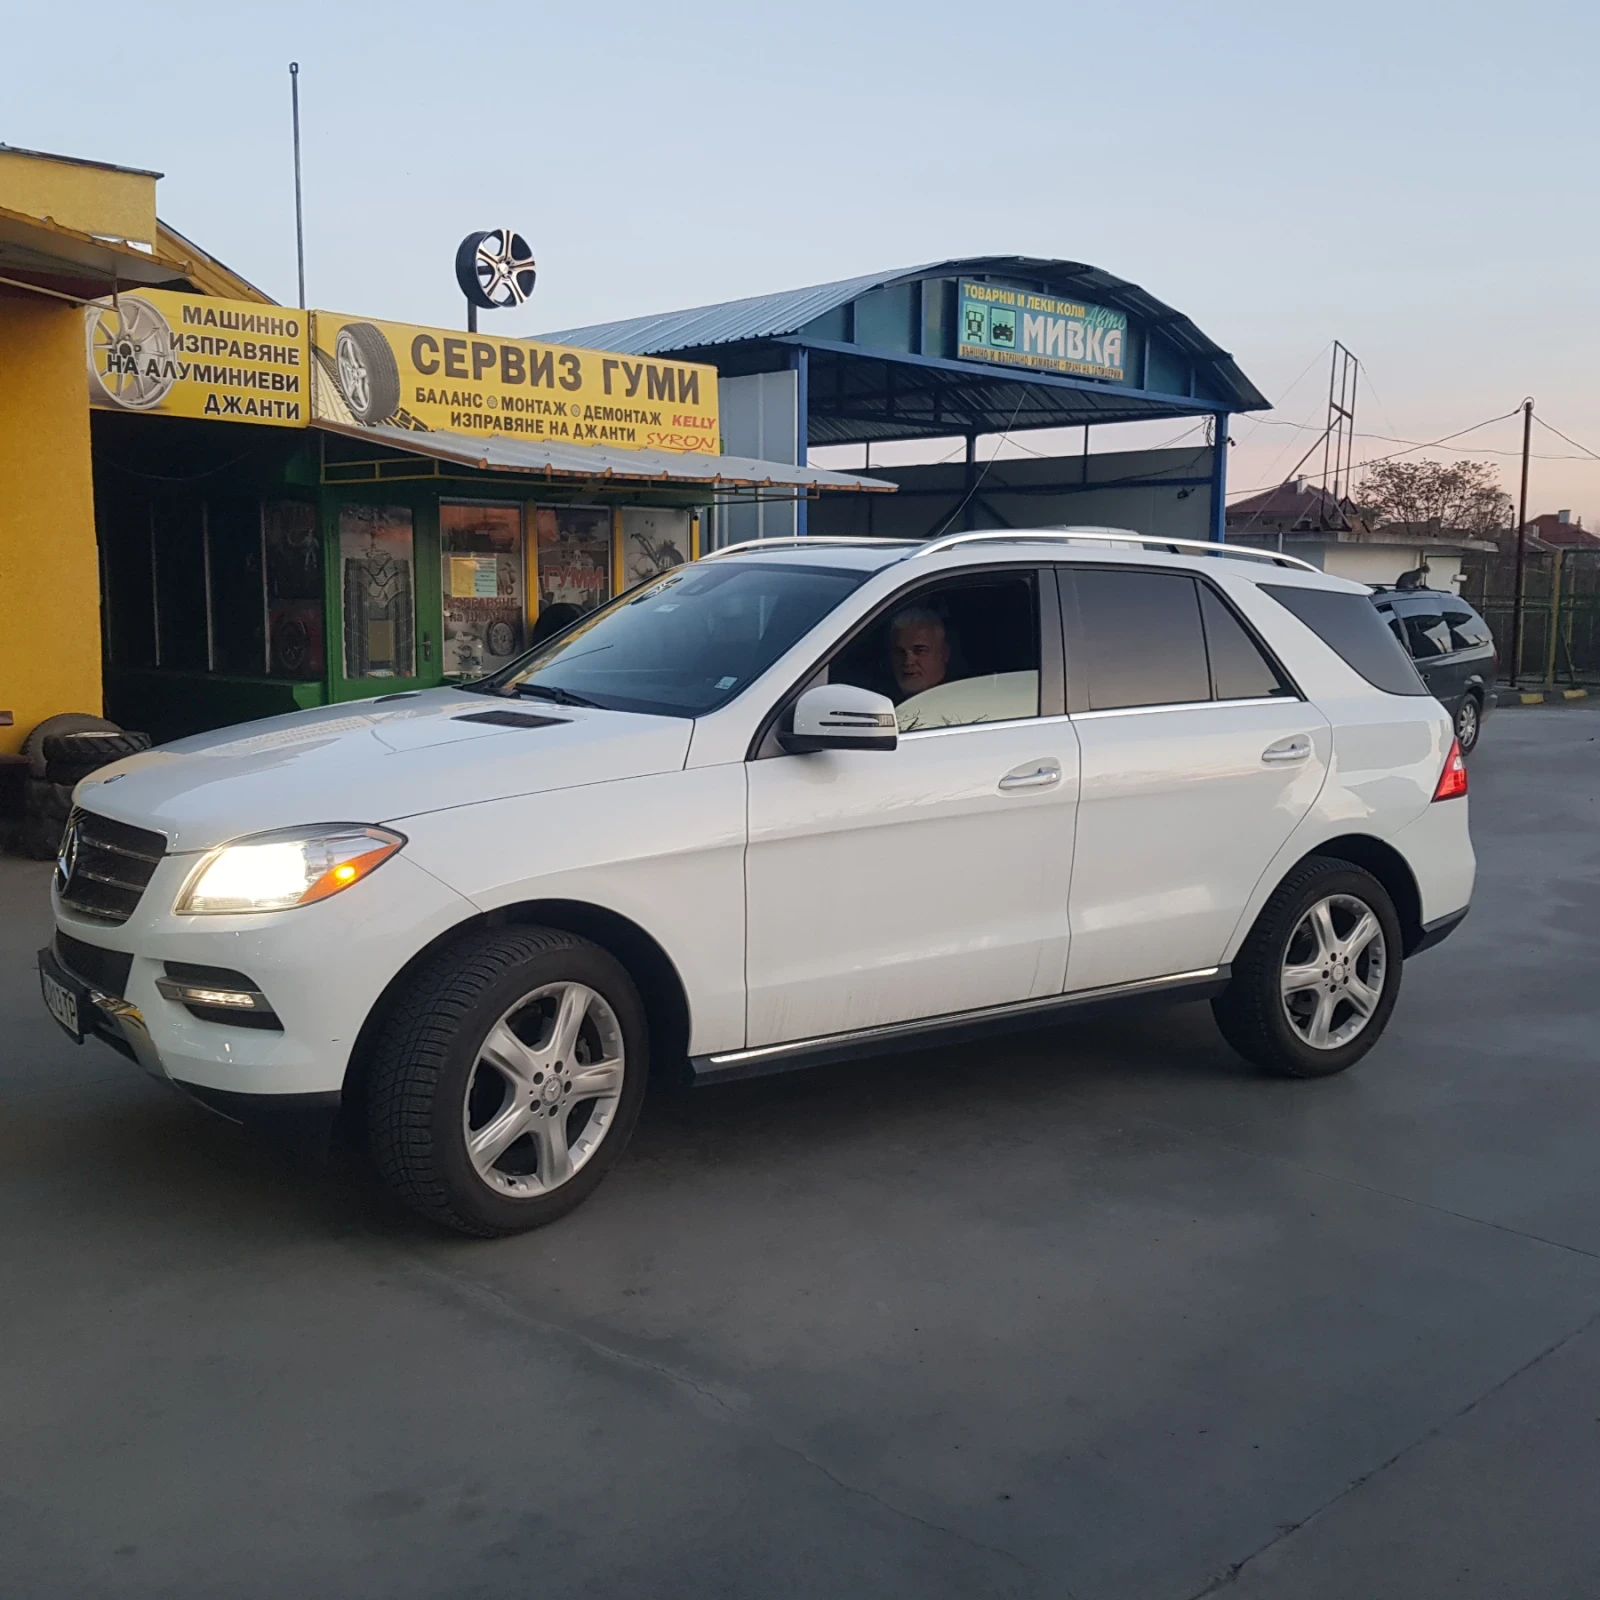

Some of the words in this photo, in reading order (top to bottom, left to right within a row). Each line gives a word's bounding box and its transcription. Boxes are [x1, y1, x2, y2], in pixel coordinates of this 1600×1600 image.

[964, 284, 1015, 305] ТОВАРНИ
[1017, 294, 1025, 307] И
[1027, 296, 1055, 313] ЛЕКИ
[1057, 302, 1086, 318] КОЛИ
[182, 305, 299, 338] МАШИННО
[1084, 306, 1126, 330] Авто
[169, 332, 299, 365] ИЗПРАВЯНЕ
[1023, 312, 1122, 368] МИВКА
[107, 354, 139, 375] НА
[146, 358, 299, 393] АЛУМИНИЕВИ
[411, 334, 583, 392] СЕРВИЗ
[602, 358, 700, 405] ГУМИ
[204, 394, 299, 420] ДЖАНТИ
[416, 387, 483, 409] БАЛАНС
[501, 396, 567, 417] МОНТАЖ
[584, 405, 662, 426] ДЕМОНТАЖ
[672, 414, 716, 429] KELLY
[451, 411, 544, 434] ИЗПРАВЯНЕ
[550, 421, 569, 437] НА
[573, 423, 636, 442] ДЖАНТИ
[647, 432, 715, 450] SYRON
[544, 565, 604, 590] ГУМИ
